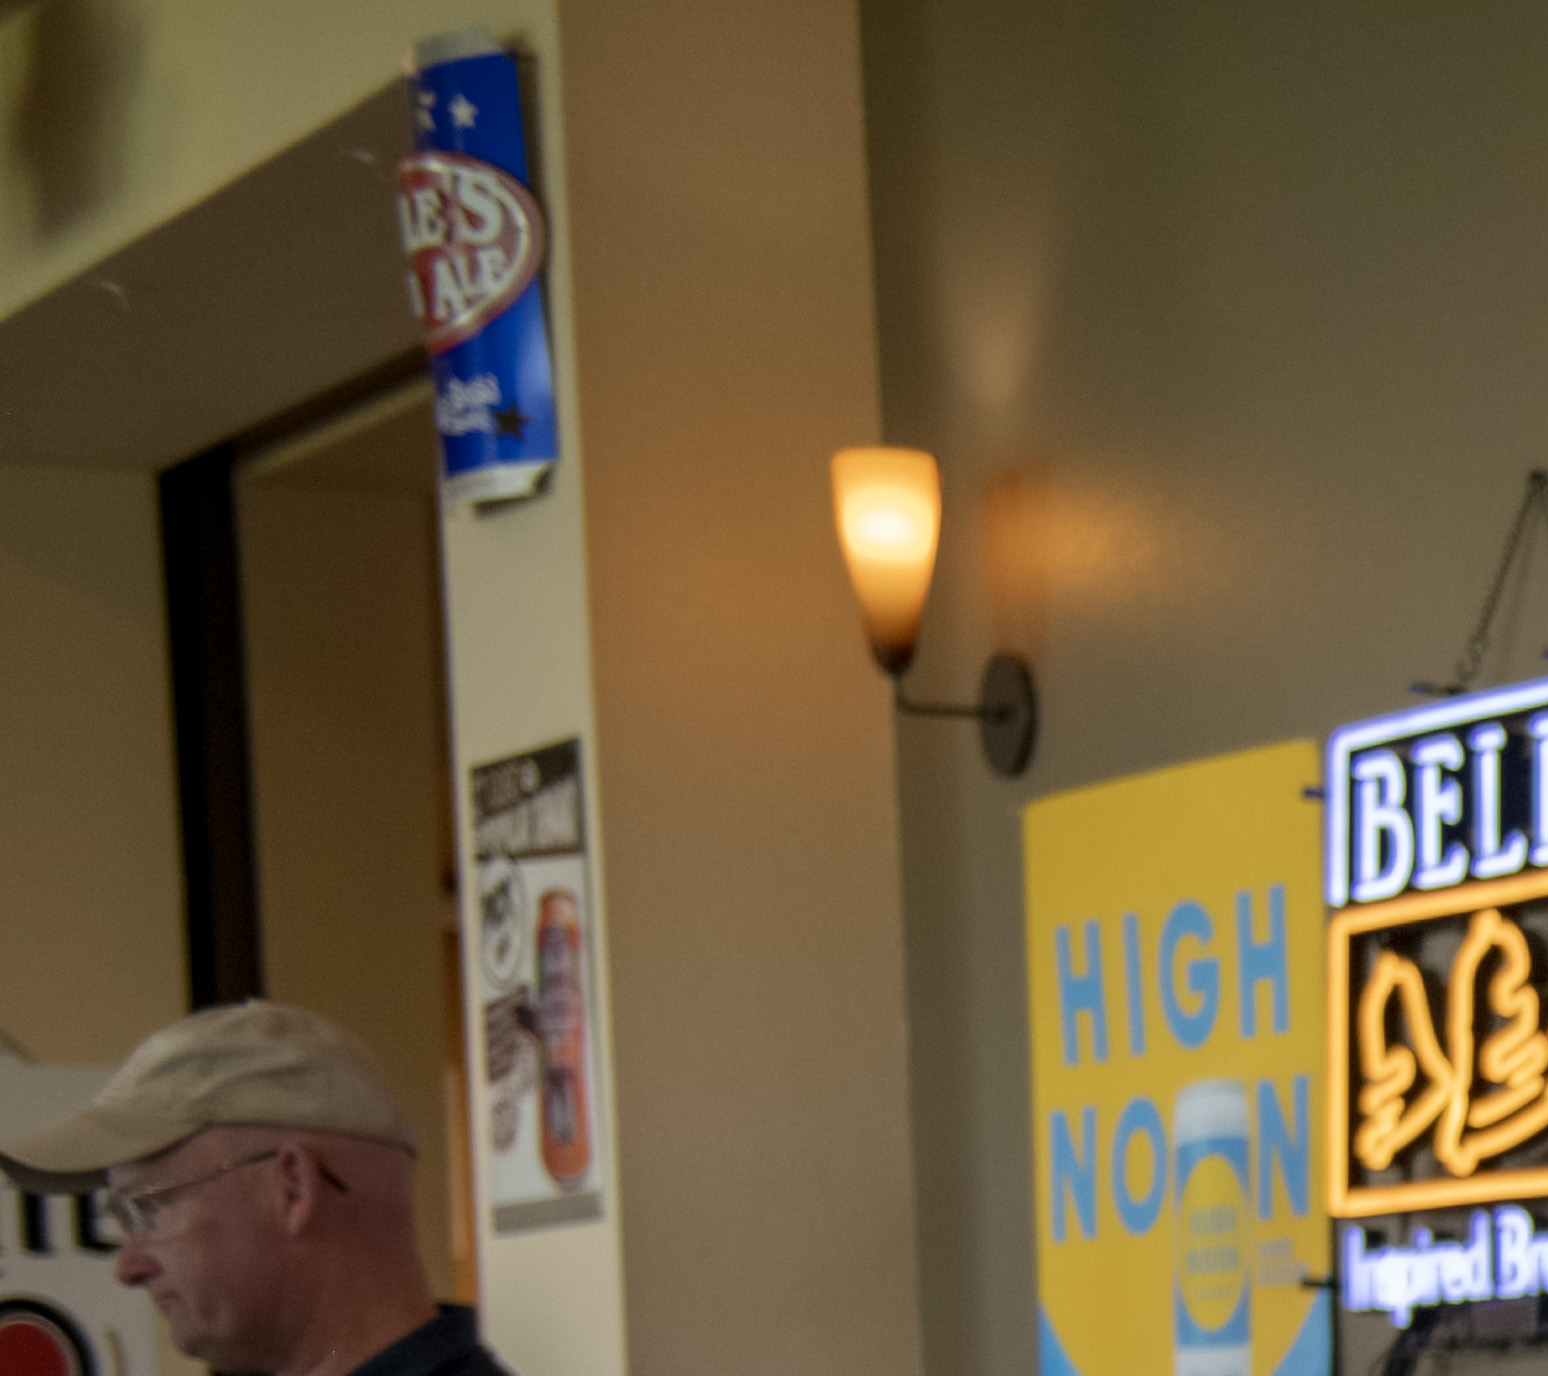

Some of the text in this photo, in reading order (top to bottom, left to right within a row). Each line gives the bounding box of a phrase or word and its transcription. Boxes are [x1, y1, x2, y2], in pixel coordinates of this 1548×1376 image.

[1055, 884, 1291, 1067] HIGH
[1049, 1074, 1310, 1244] NON
[1342, 1212, 1493, 1328] Inspired
